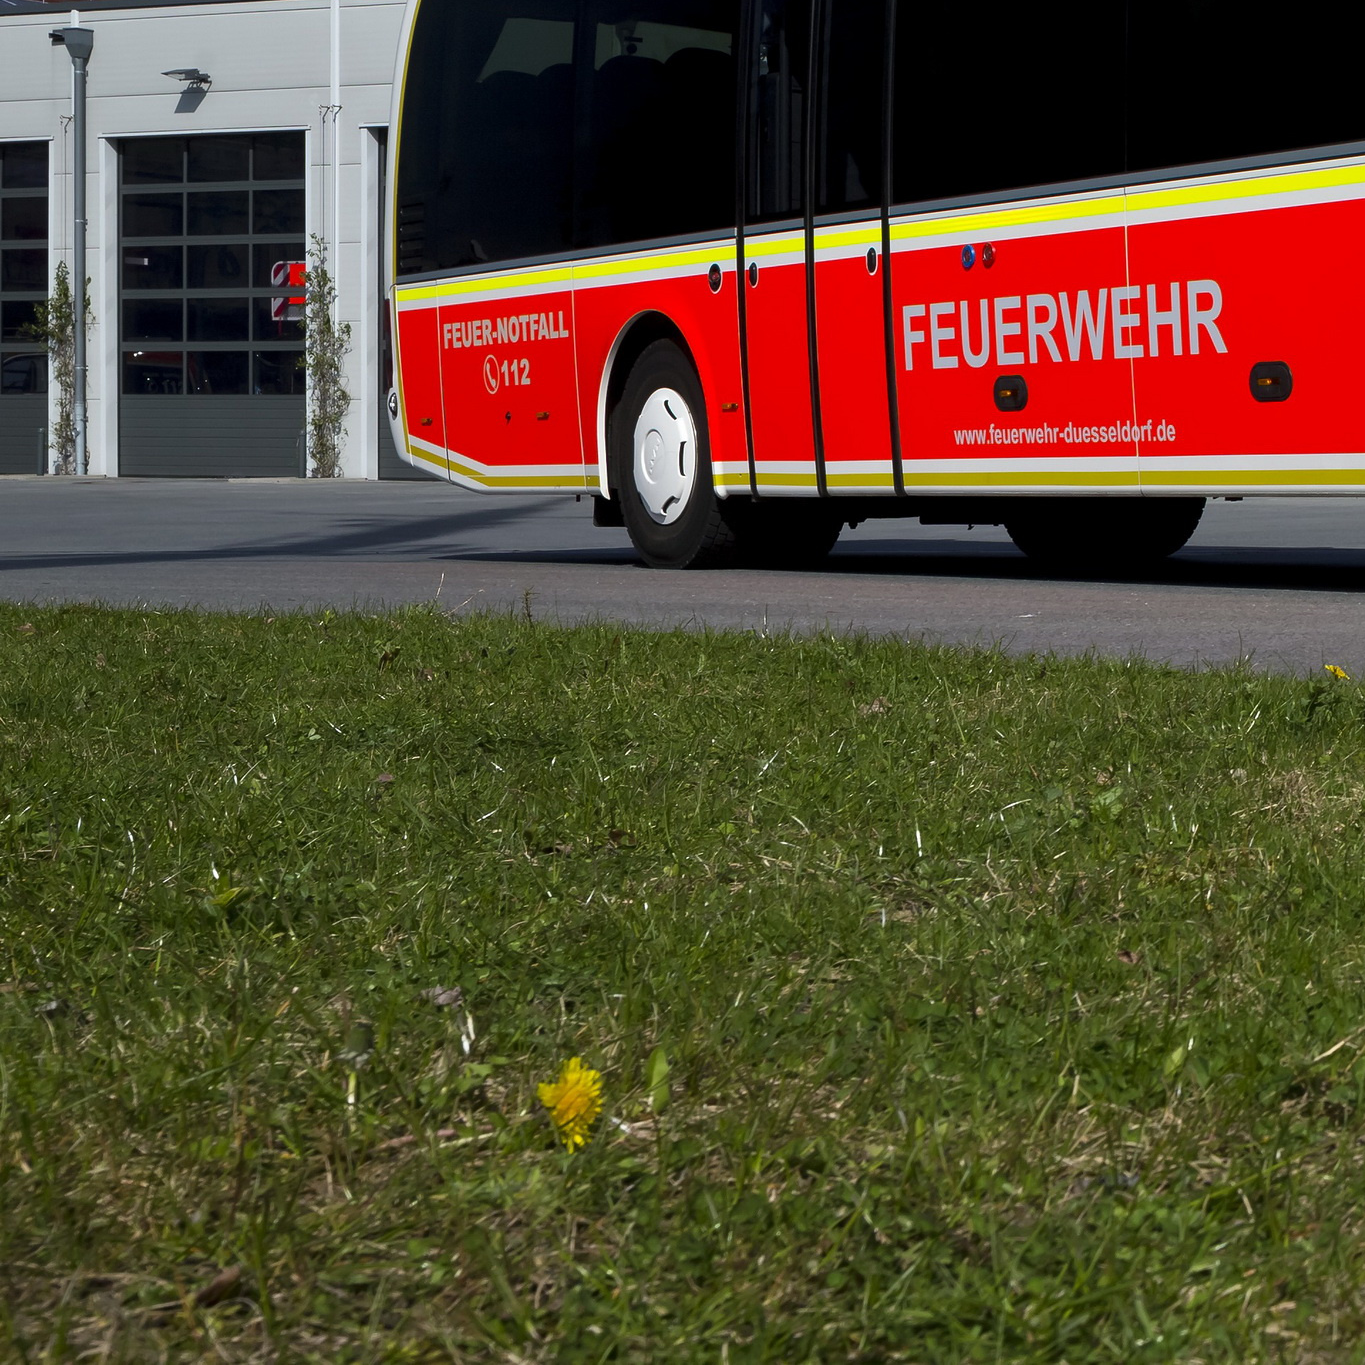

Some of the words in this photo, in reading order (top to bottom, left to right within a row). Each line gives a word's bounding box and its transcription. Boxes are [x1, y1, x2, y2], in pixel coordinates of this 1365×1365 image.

[443, 311, 569, 349] FEUER-NOTFALL
[902, 279, 1228, 371] FEUERWEHR
[501, 358, 531, 386] 112
[954, 419, 1176, 445] www.feuerwehr-duesseldorf.de
